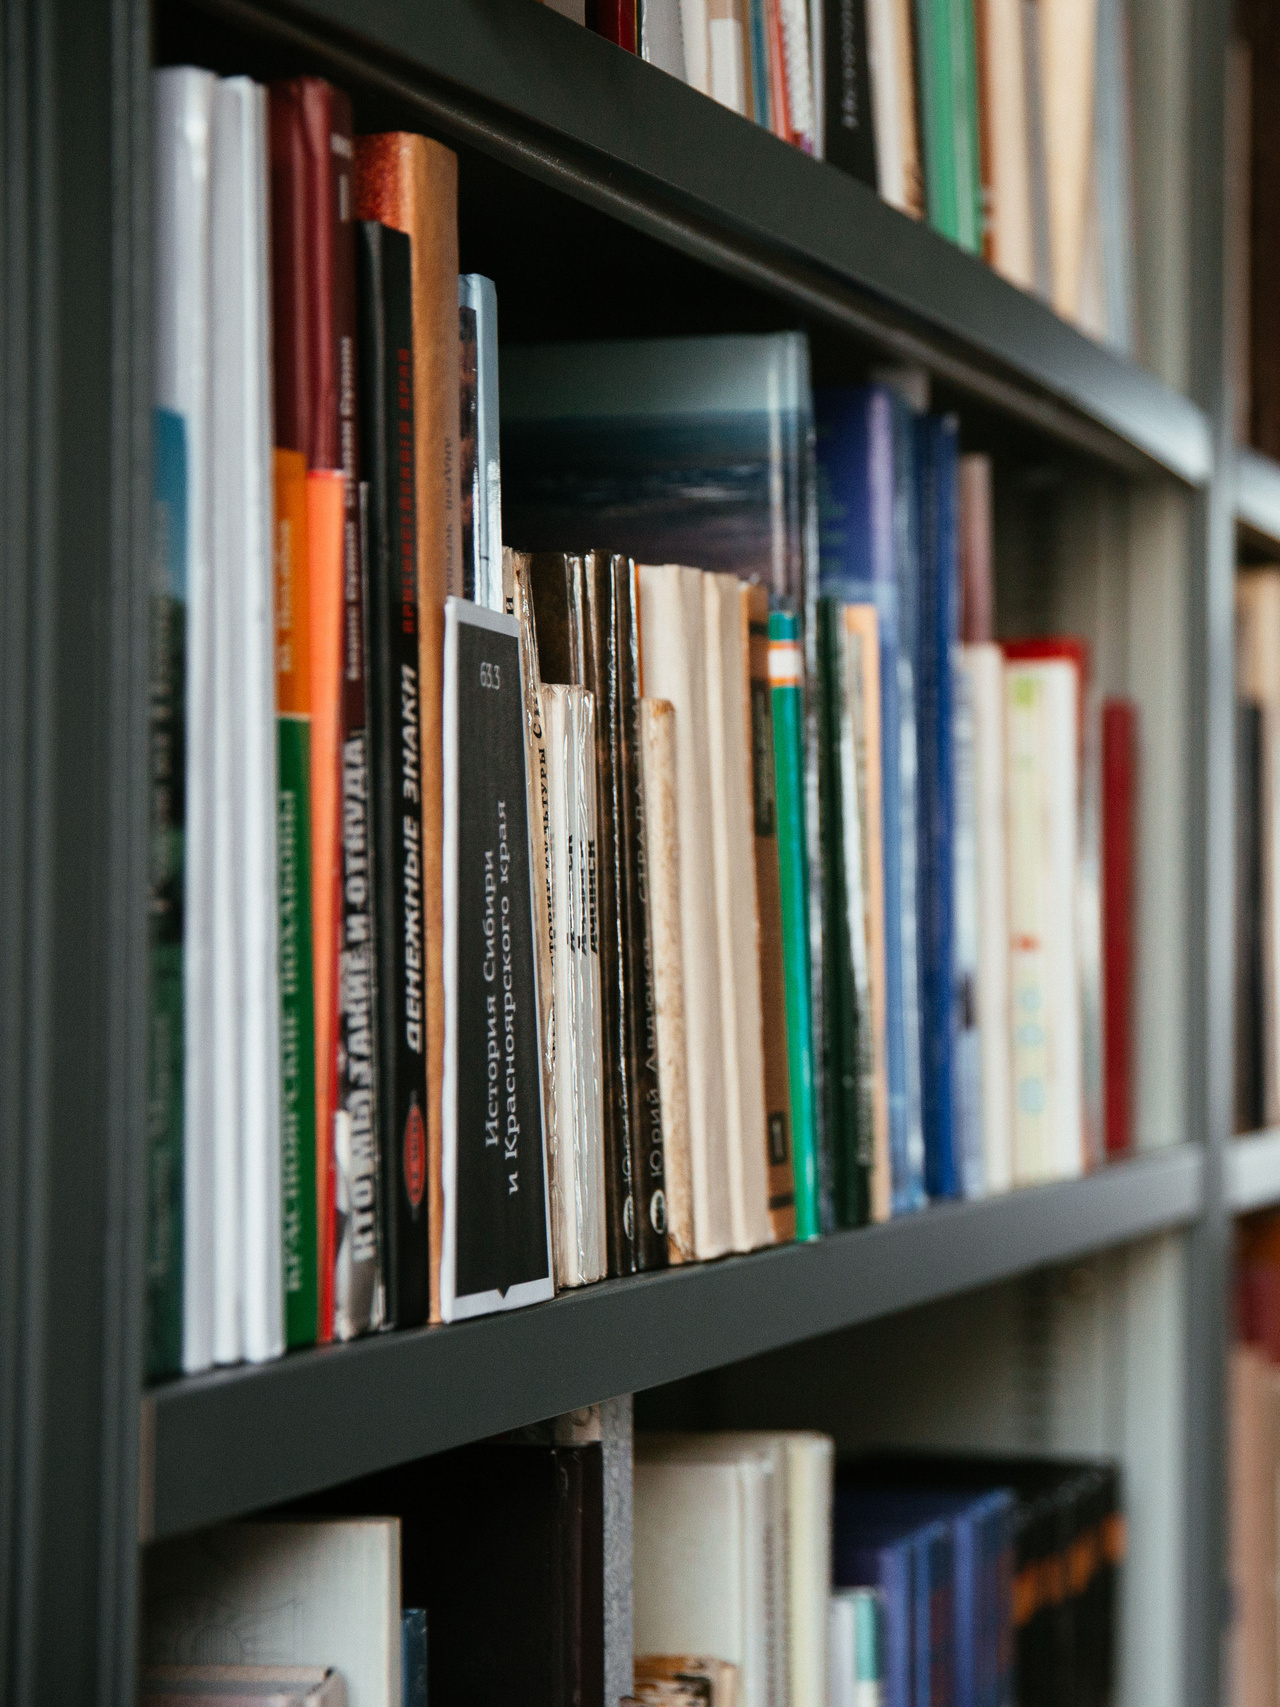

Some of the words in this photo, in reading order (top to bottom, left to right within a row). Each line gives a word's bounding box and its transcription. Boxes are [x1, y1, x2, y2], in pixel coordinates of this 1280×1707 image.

[401, 663, 421, 804] ЗНАКИ
[497, 799, 511, 884] края
[403, 815, 423, 1054] ДЕНЕЖНЫЕ
[482, 850, 497, 983] Сибири
[485, 995, 501, 1148] История
[501, 895, 520, 1160] Красноярского
[508, 1170, 519, 1195] и
